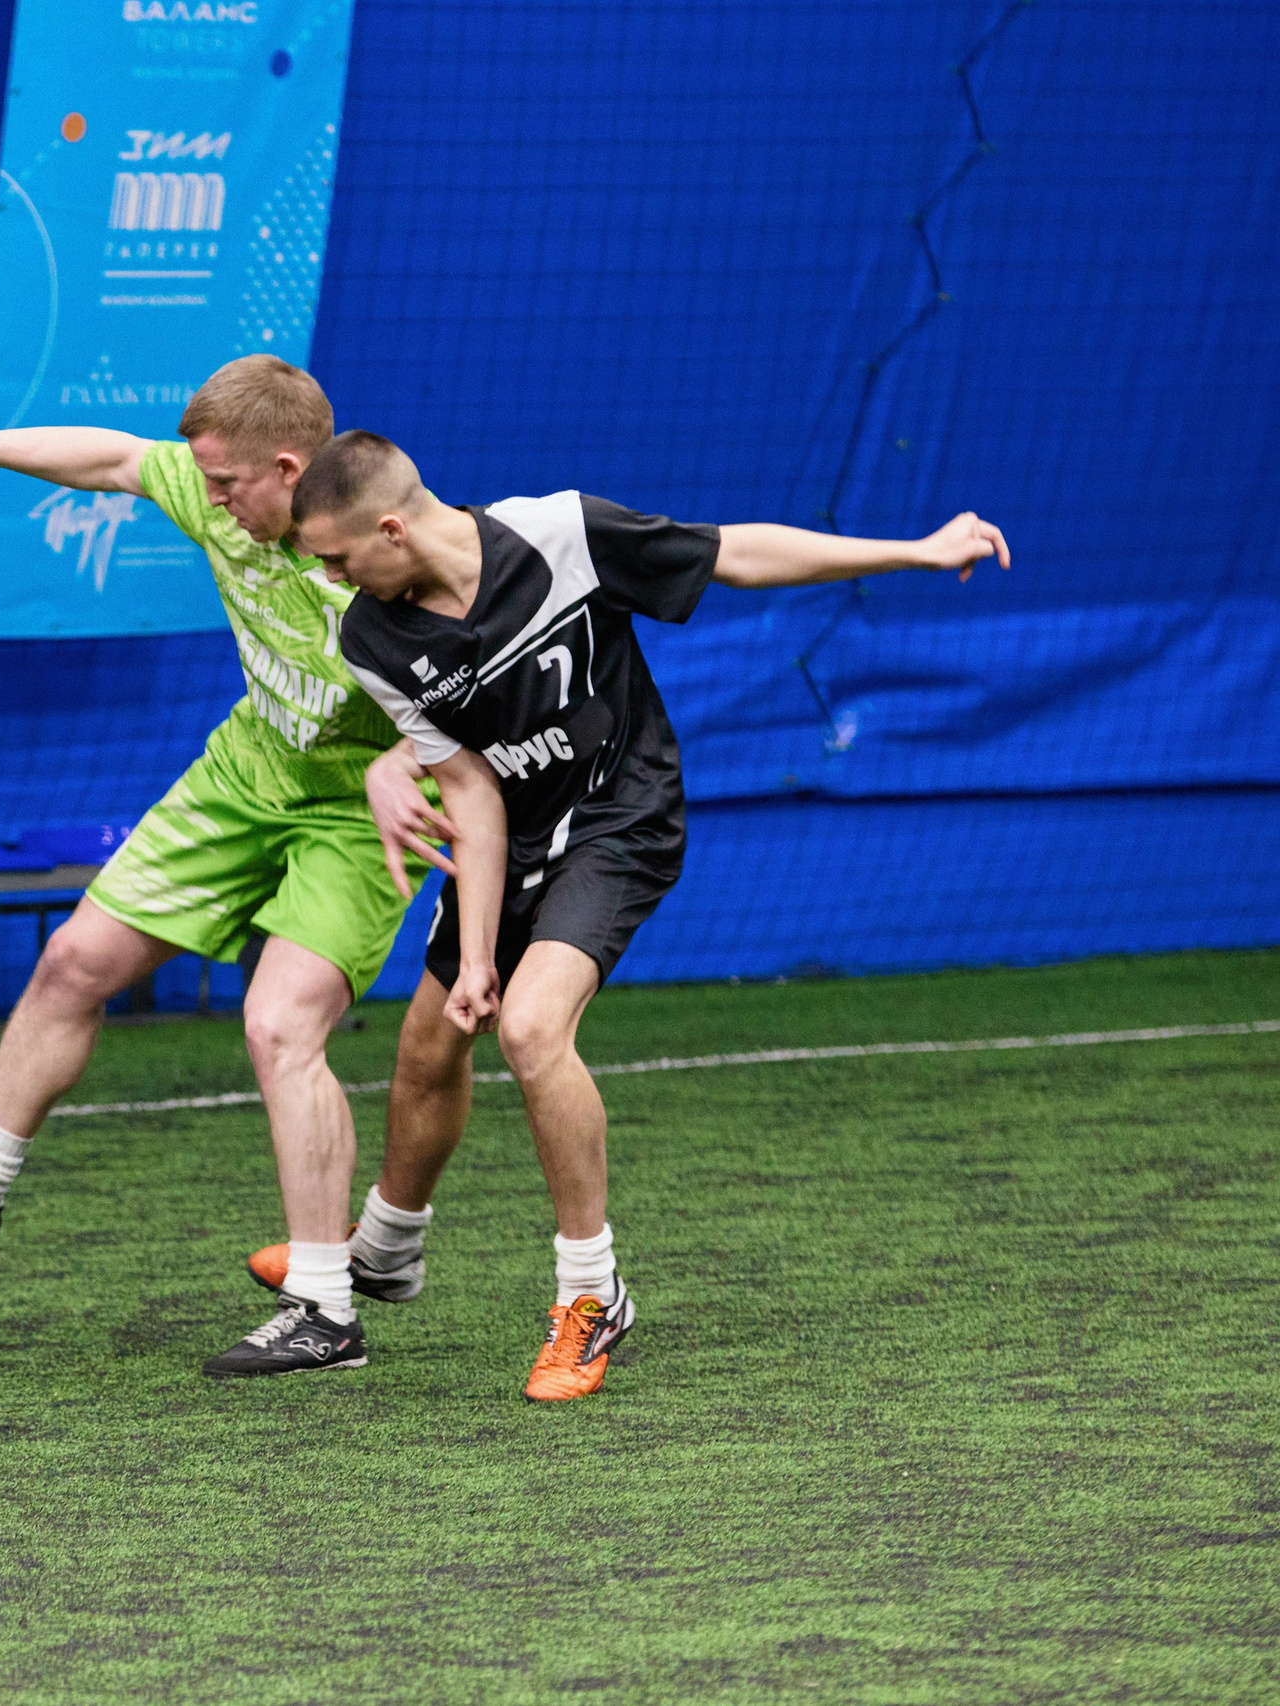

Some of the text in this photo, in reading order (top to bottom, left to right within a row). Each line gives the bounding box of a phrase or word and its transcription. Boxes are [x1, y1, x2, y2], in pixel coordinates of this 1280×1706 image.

[322, 603, 344, 658] 1
[413, 664, 473, 711] АЛЬЯНС
[537, 645, 572, 709] 7
